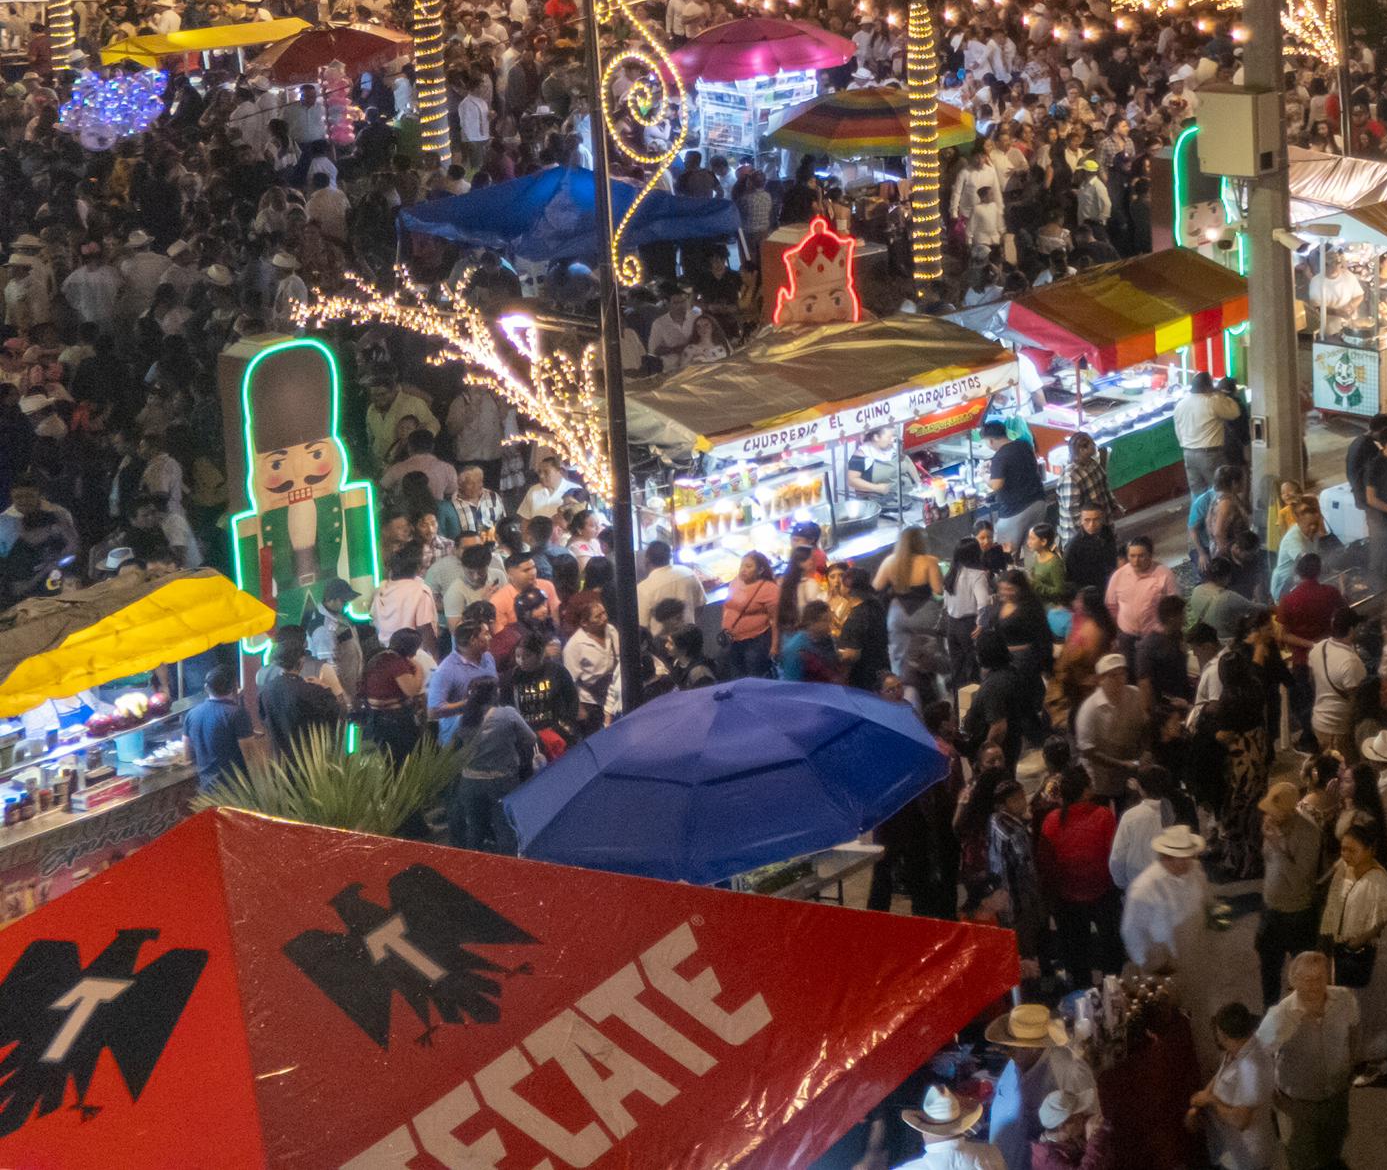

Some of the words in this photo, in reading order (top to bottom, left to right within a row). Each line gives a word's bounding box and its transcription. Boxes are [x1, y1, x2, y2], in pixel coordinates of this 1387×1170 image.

[743, 422, 819, 452] CHURRERIA
[829, 416, 844, 429] EL
[856, 401, 891, 423] CHINO
[908, 376, 982, 408] MARQUESITAS
